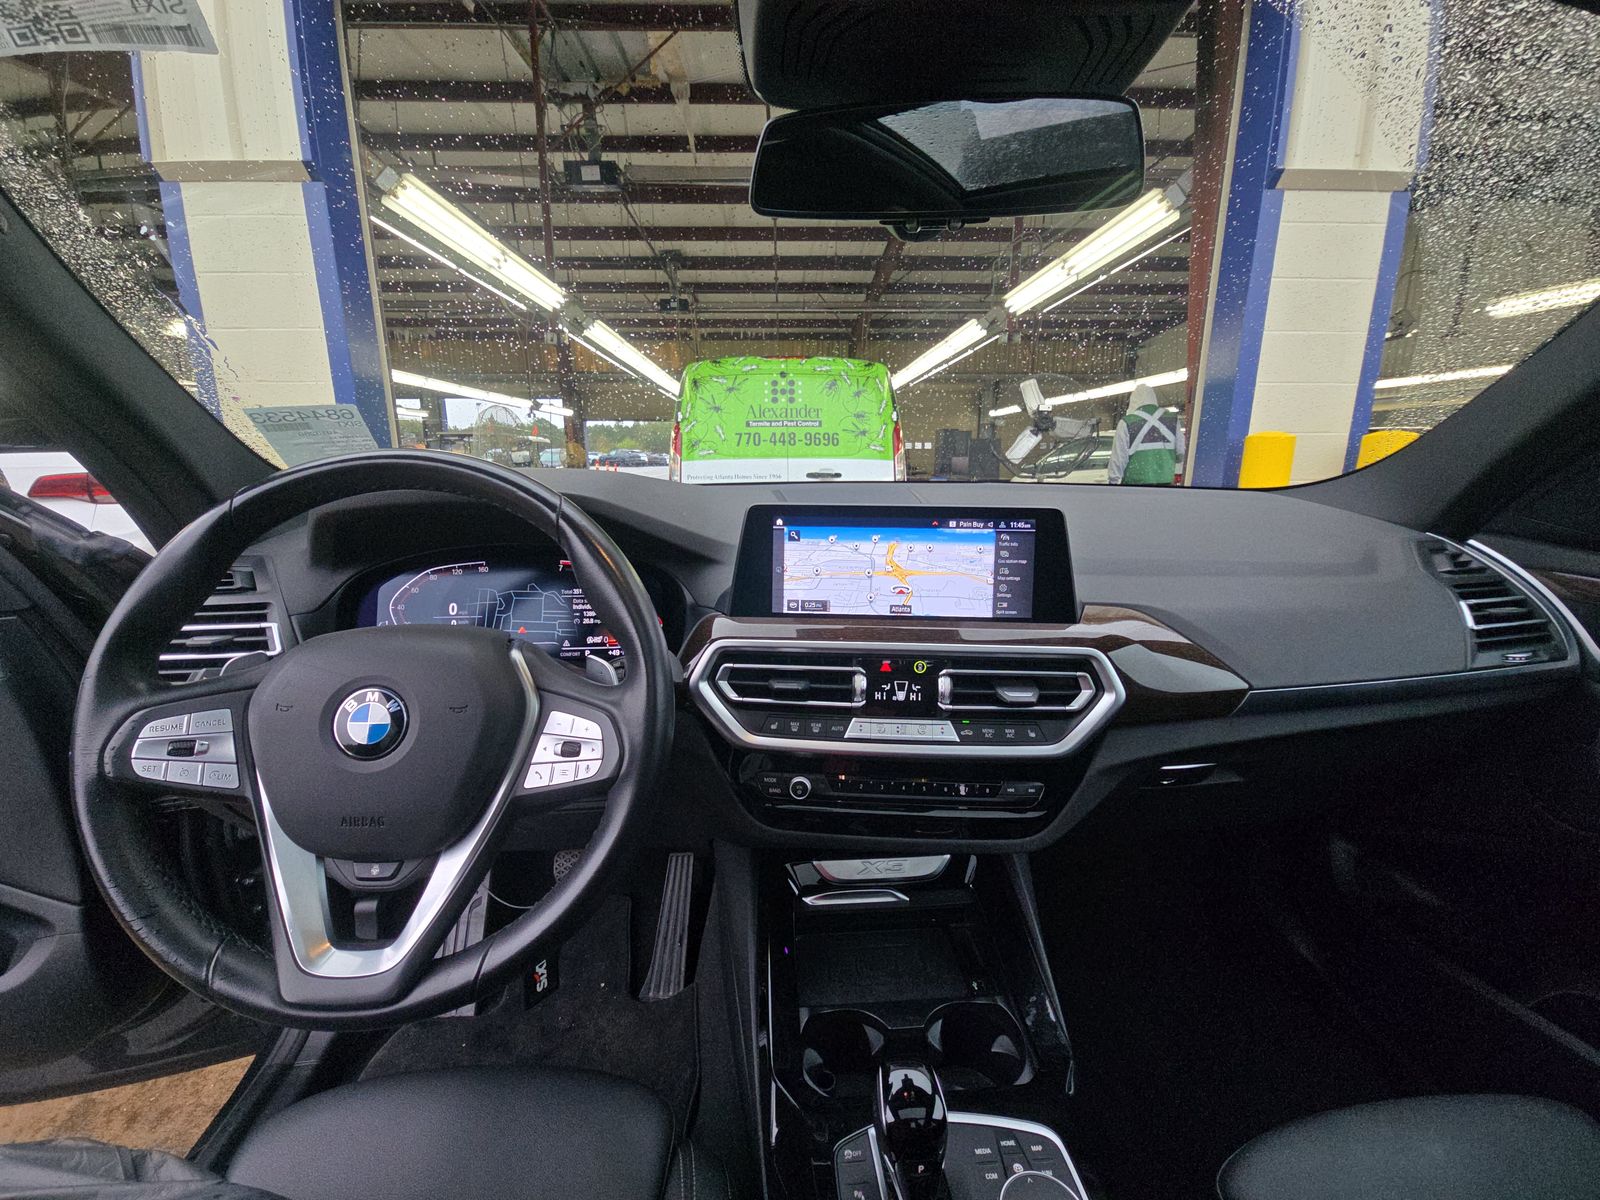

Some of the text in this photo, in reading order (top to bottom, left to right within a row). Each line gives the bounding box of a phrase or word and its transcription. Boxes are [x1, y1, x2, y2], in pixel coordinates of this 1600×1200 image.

[746, 404, 822, 418] Alexander
[735, 432, 840, 447] 770-448-9696
[449, 603, 458, 615] 0
[875, 692, 886, 700] HI
[910, 692, 921, 701] HI
[344, 692, 400, 712] BMW
[149, 723, 183, 733] RESUME
[195, 719, 226, 728] CANCEL
[341, 816, 385, 827] AIRBAG
[857, 860, 908, 876] X3
[918, 1165, 924, 1174] P
